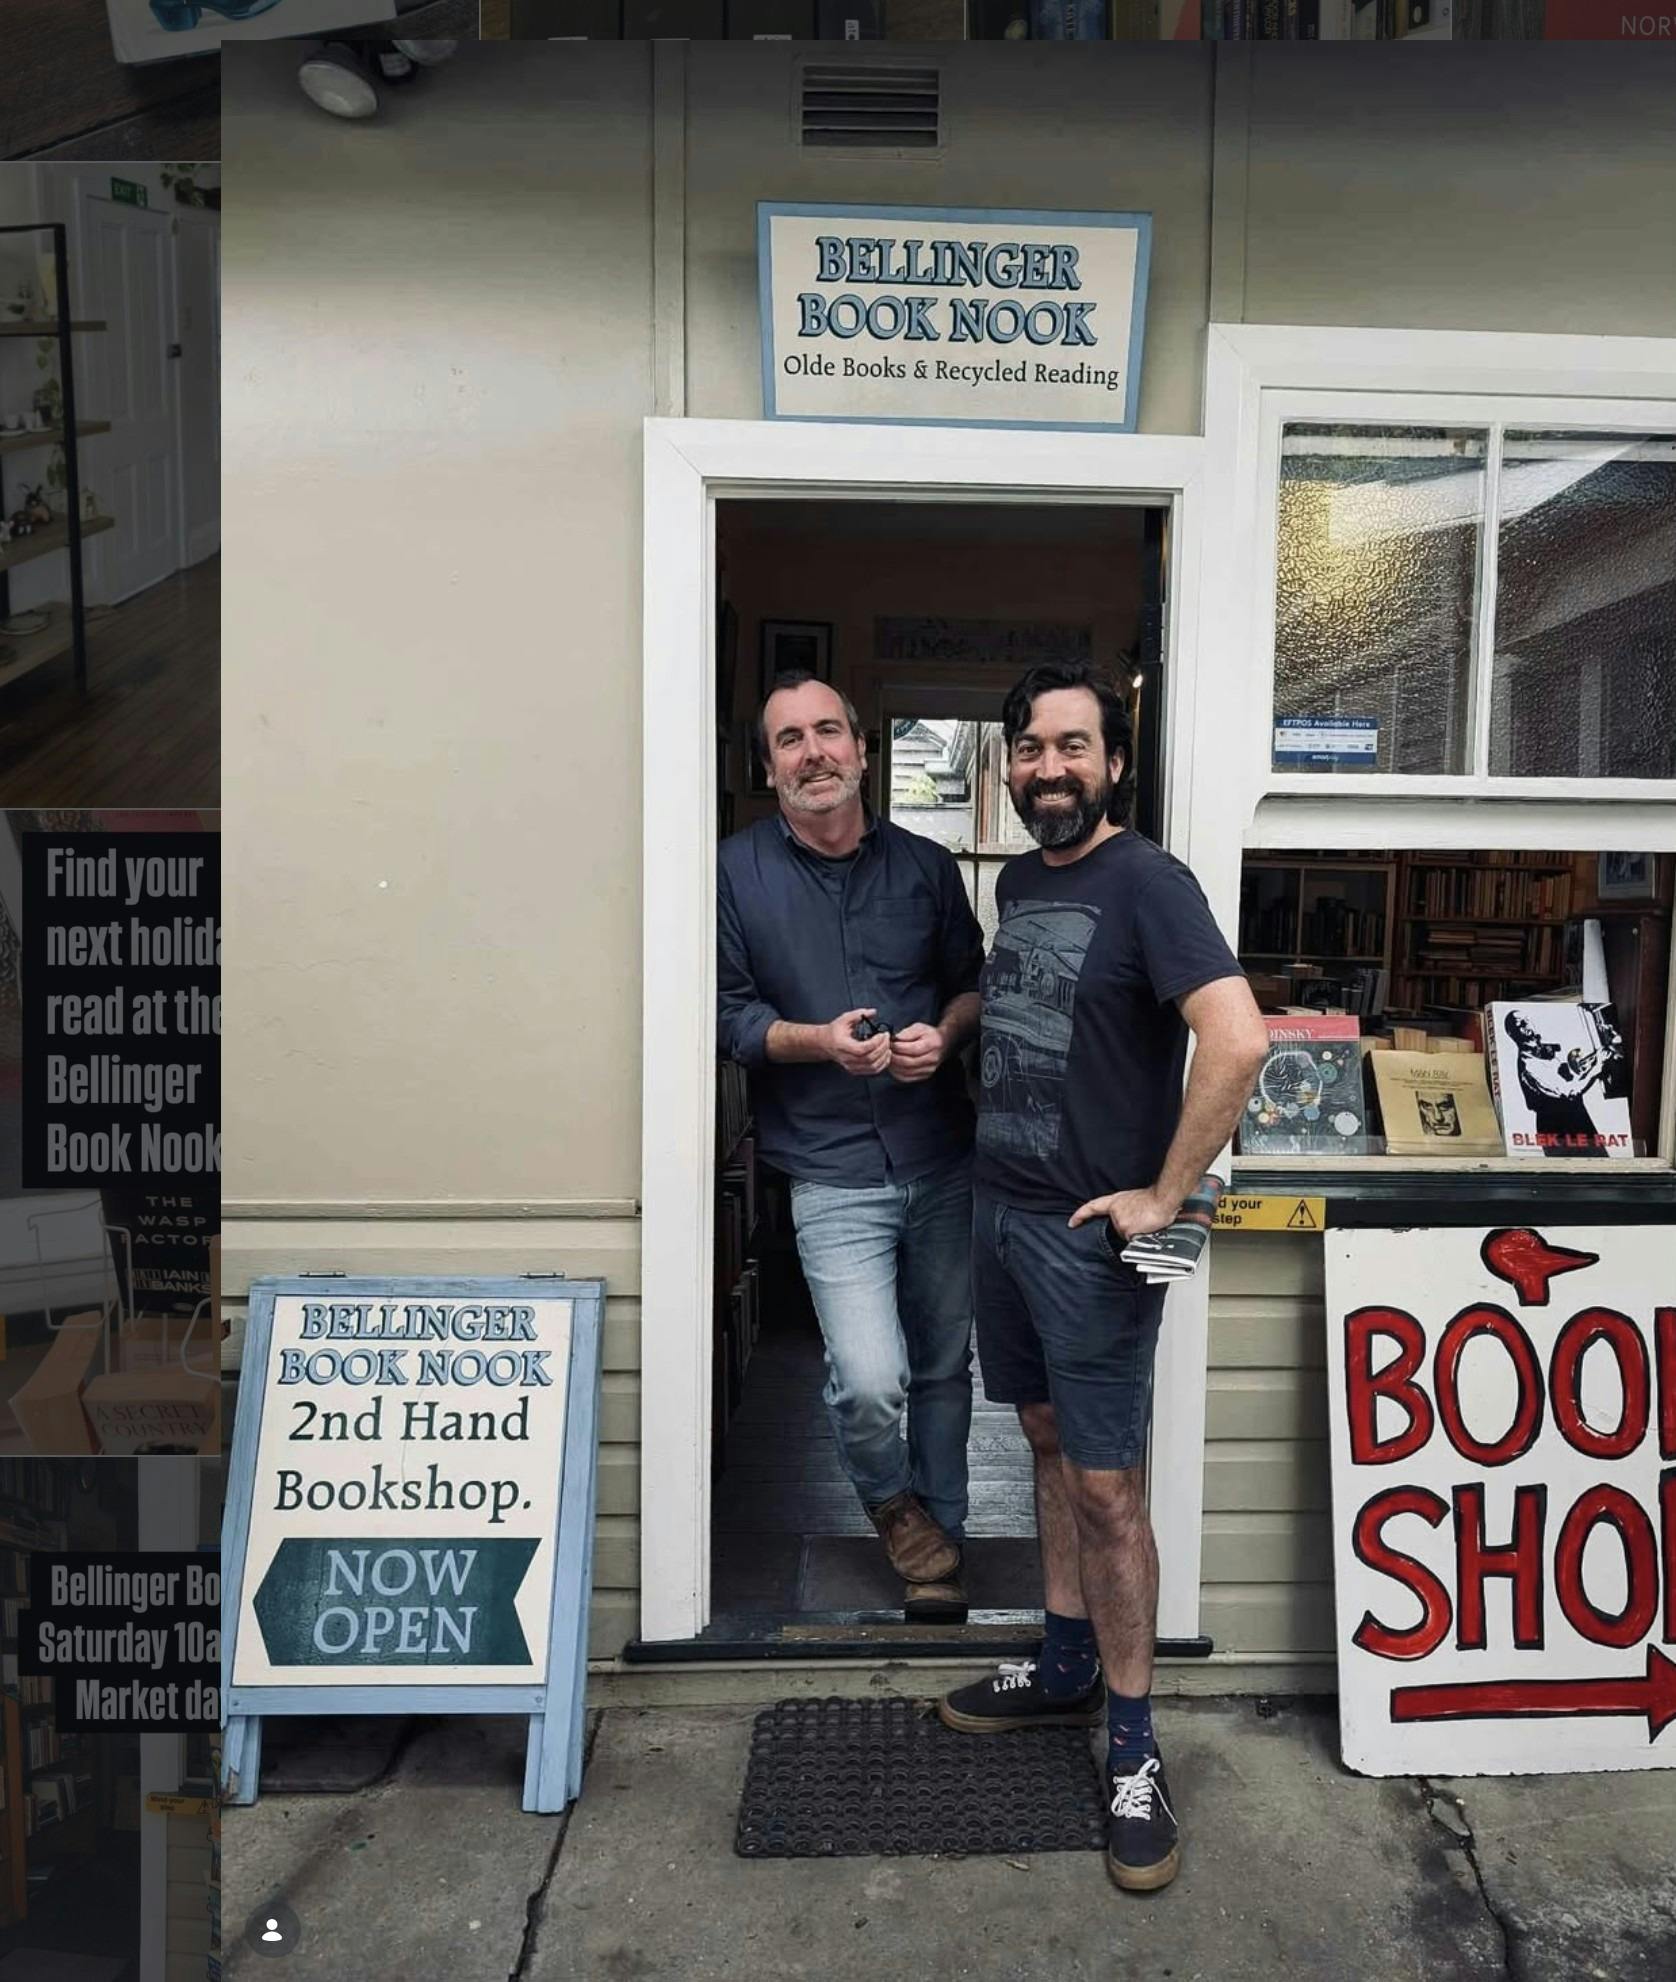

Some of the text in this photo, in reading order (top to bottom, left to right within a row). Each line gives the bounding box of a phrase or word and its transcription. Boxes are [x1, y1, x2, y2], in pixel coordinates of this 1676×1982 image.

[1621, 15, 1676, 36] NOR
[815, 235, 1082, 291] BELLINGER
[797, 293, 1098, 346] BOOK NOOK
[783, 353, 1119, 390] Olde Books & Recycled Reading
[1283, 719, 1370, 728] EFTPOS Available Here
[1512, 1133, 1628, 1147] BLEK LE RAT
[145, 1196, 193, 1208] THE
[1232, 1199, 1262, 1211] your
[138, 1215, 206, 1227] WASP
[1212, 1214, 1242, 1227] step
[120, 1233, 212, 1246] FACTOR
[163, 1269, 199, 1281] IAIN
[300, 1303, 539, 1341] BELLINGER
[277, 1348, 553, 1387] BOOK NOOK
[289, 1396, 530, 1441] 2nd Hand
[102, 1423, 207, 1436] COUNTRY
[274, 1464, 531, 1523] Bookshop.
[323, 1549, 479, 1597] NOW
[313, 1606, 479, 1655] OPEN
